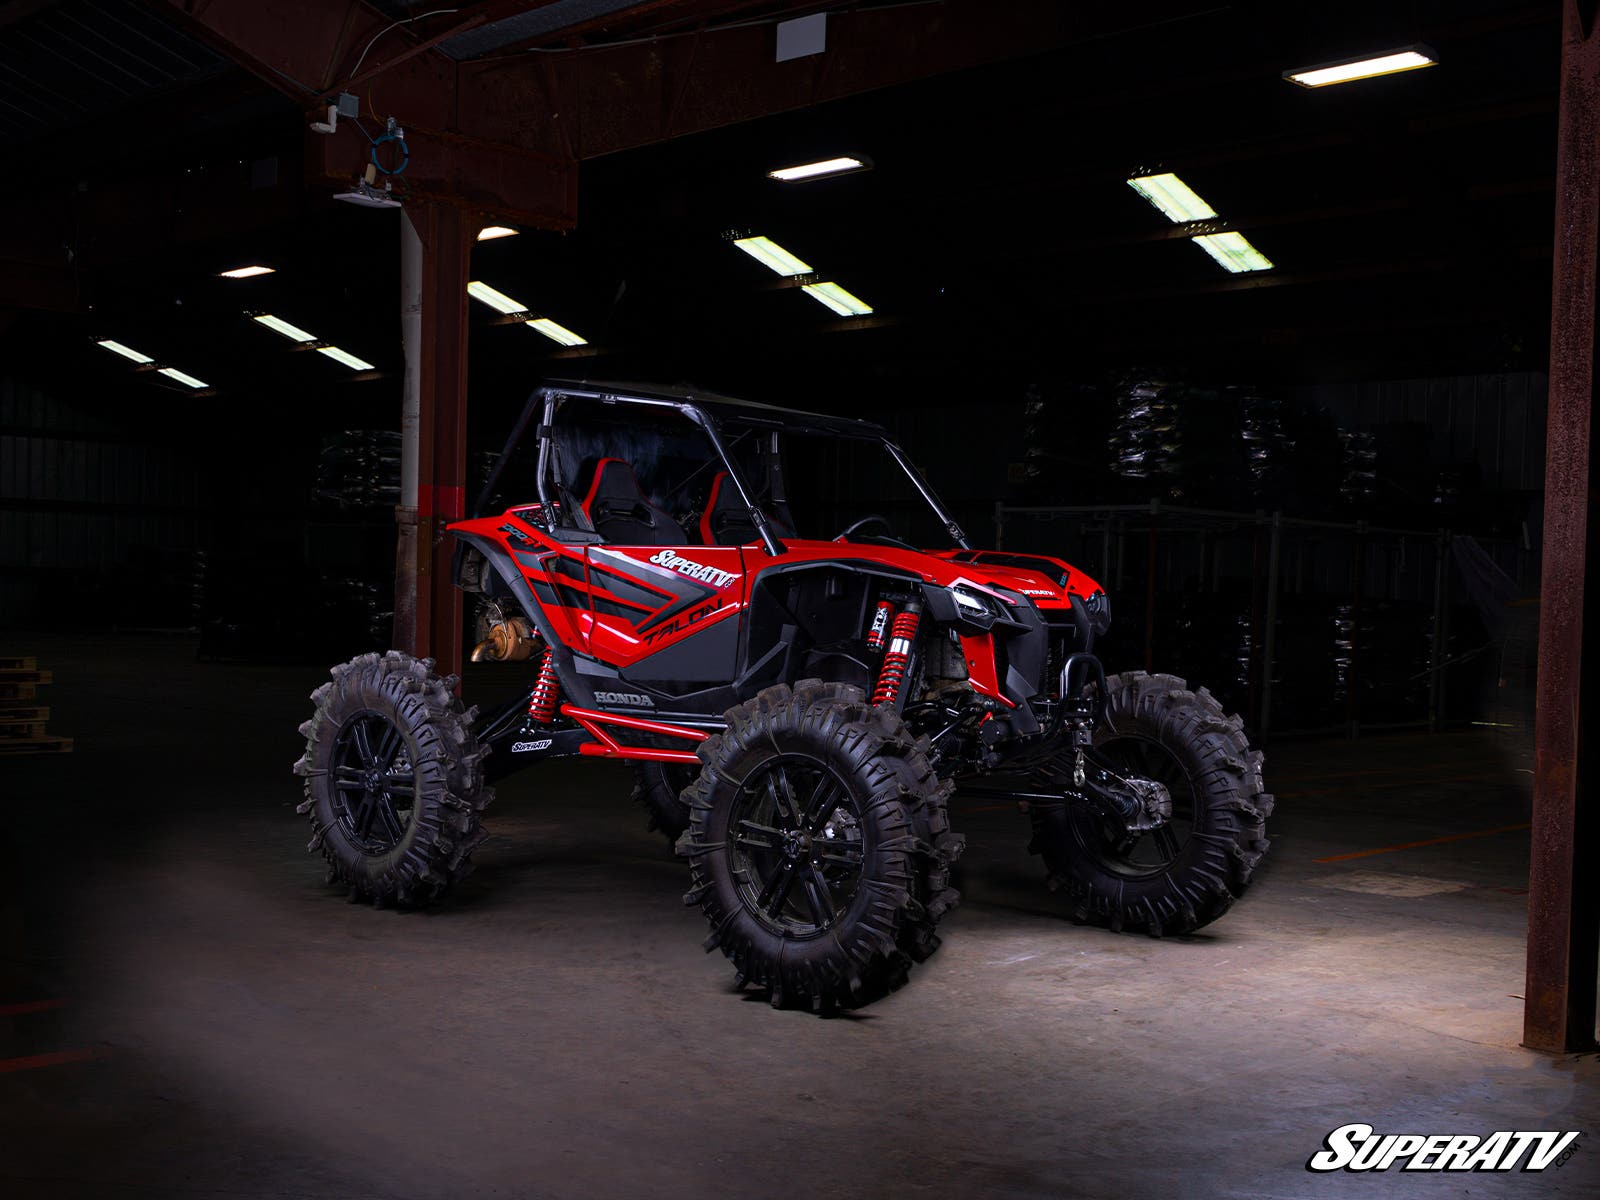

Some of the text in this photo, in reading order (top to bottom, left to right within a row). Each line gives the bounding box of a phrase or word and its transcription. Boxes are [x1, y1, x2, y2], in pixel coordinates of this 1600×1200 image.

[649, 550, 742, 587] SUPERATV
[643, 598, 722, 646] TALON
[871, 606, 888, 632] FOX
[594, 691, 655, 707] HONDA
